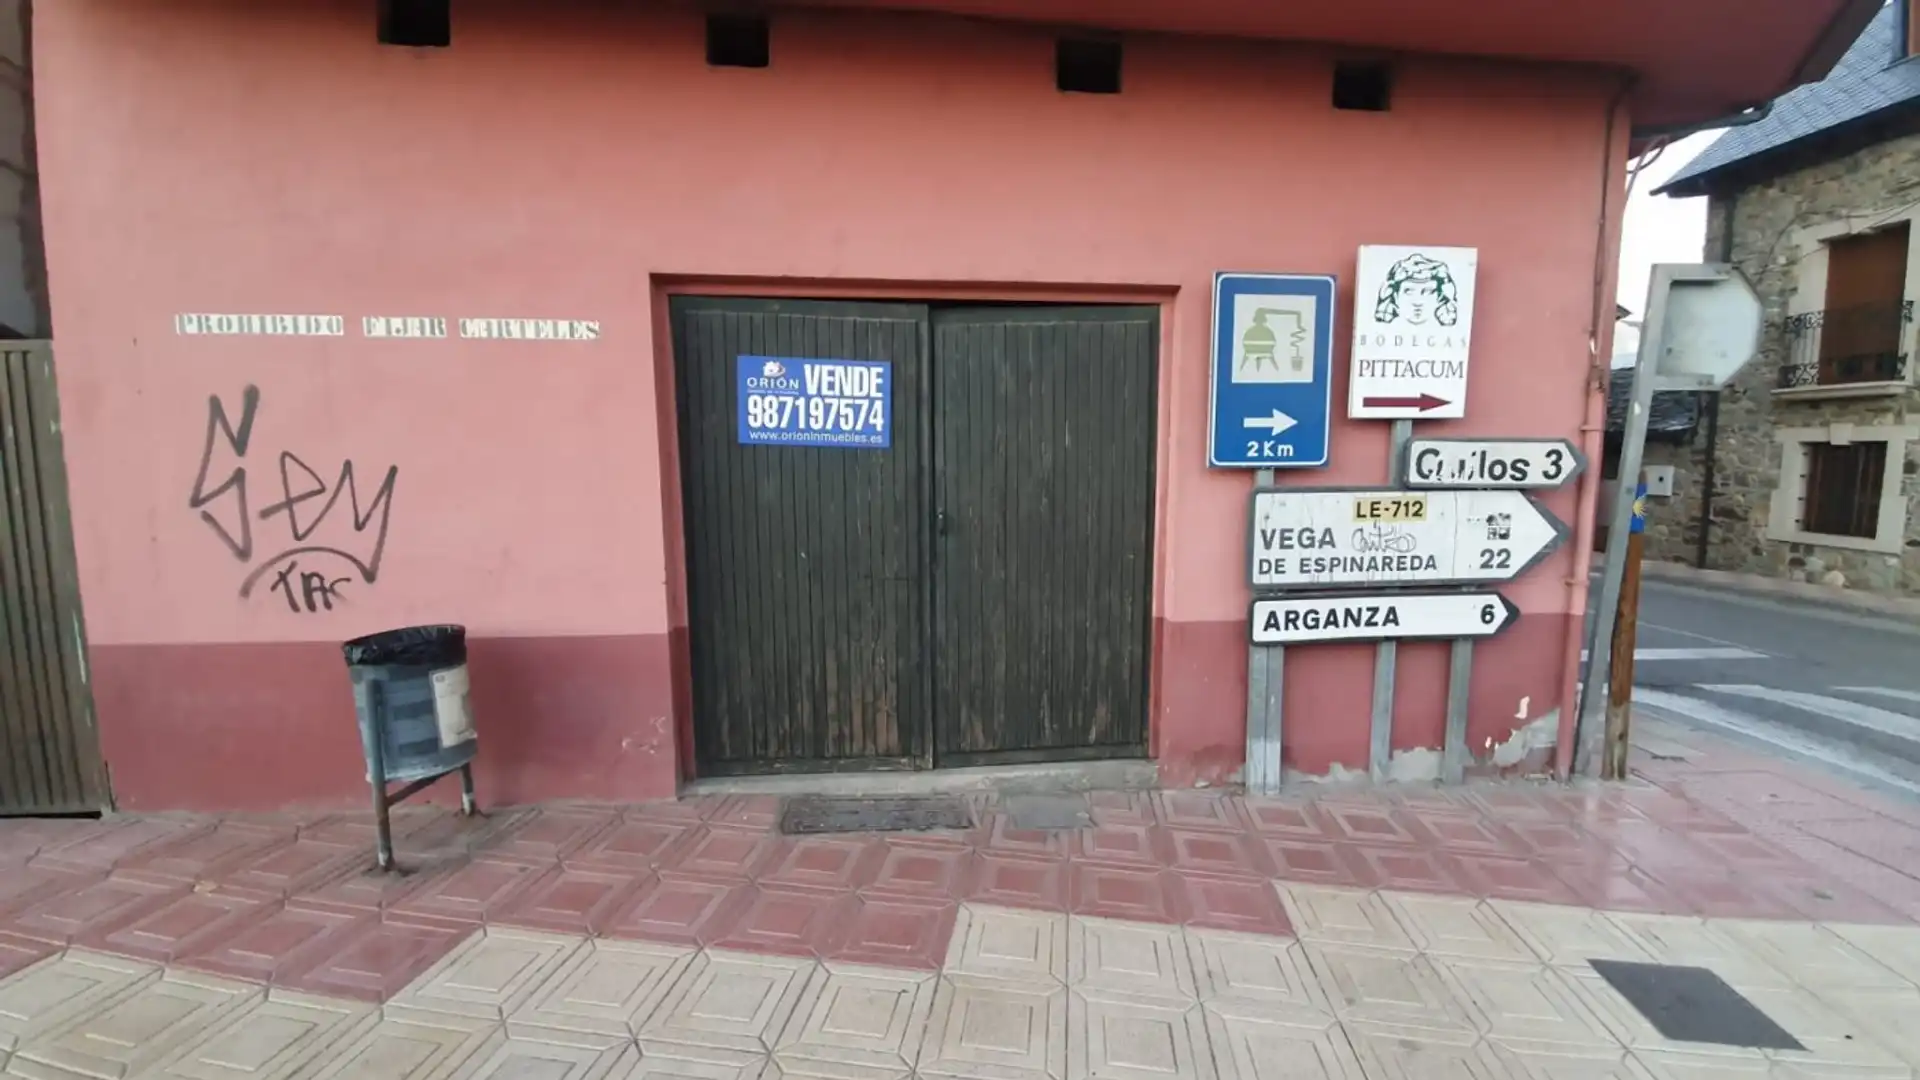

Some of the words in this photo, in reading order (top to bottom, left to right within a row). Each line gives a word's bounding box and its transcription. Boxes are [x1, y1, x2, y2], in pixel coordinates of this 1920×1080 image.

[1360, 333, 1467, 348] BODEGAS
[1358, 359, 1464, 378] PITTACUM
[804, 363, 884, 398] VENDE
[748, 394, 884, 431] 987197574
[750, 430, 883, 444] www.orioninmuebles.es
[1246, 441, 1260, 457] 2
[1263, 441, 1294, 457] Km
[1541, 448, 1564, 480] 3
[1356, 500, 1424, 519] LE-712
[1261, 528, 1337, 550] VEGA
[1258, 558, 1286, 576] DE
[1299, 554, 1438, 575] ESPINAREDA
[1479, 548, 1512, 569] 22
[1262, 605, 1401, 632] ARGANZA
[1480, 604, 1496, 625] 6
